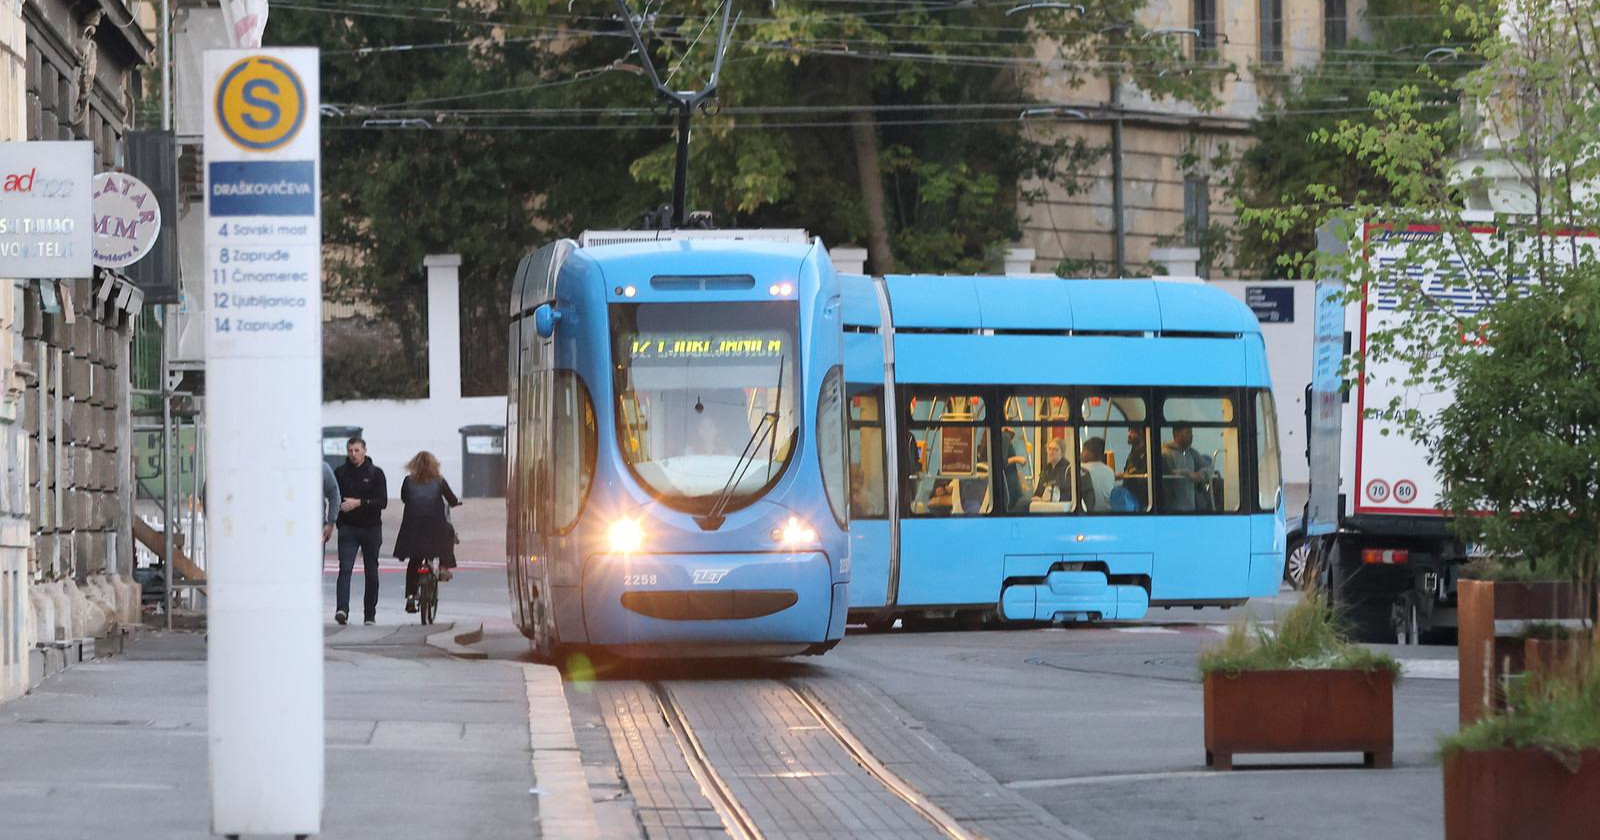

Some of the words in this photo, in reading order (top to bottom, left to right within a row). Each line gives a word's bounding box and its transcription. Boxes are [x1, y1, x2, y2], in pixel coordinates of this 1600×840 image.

[240, 78, 281, 130] S
[213, 179, 311, 196] DRAŠKOVIĆEVA
[218, 223, 229, 237] 4
[233, 224, 274, 236] Savski
[277, 224, 307, 236] most
[219, 247, 230, 264] 8
[213, 268, 227, 285] 11
[232, 268, 308, 283] Črnomerec
[214, 292, 229, 308] 12
[232, 294, 306, 309] Ljubljanica
[215, 317, 230, 333] 14
[1367, 409, 1423, 421] CRATA
[1372, 485, 1385, 496] 70
[1399, 485, 1412, 496] 80
